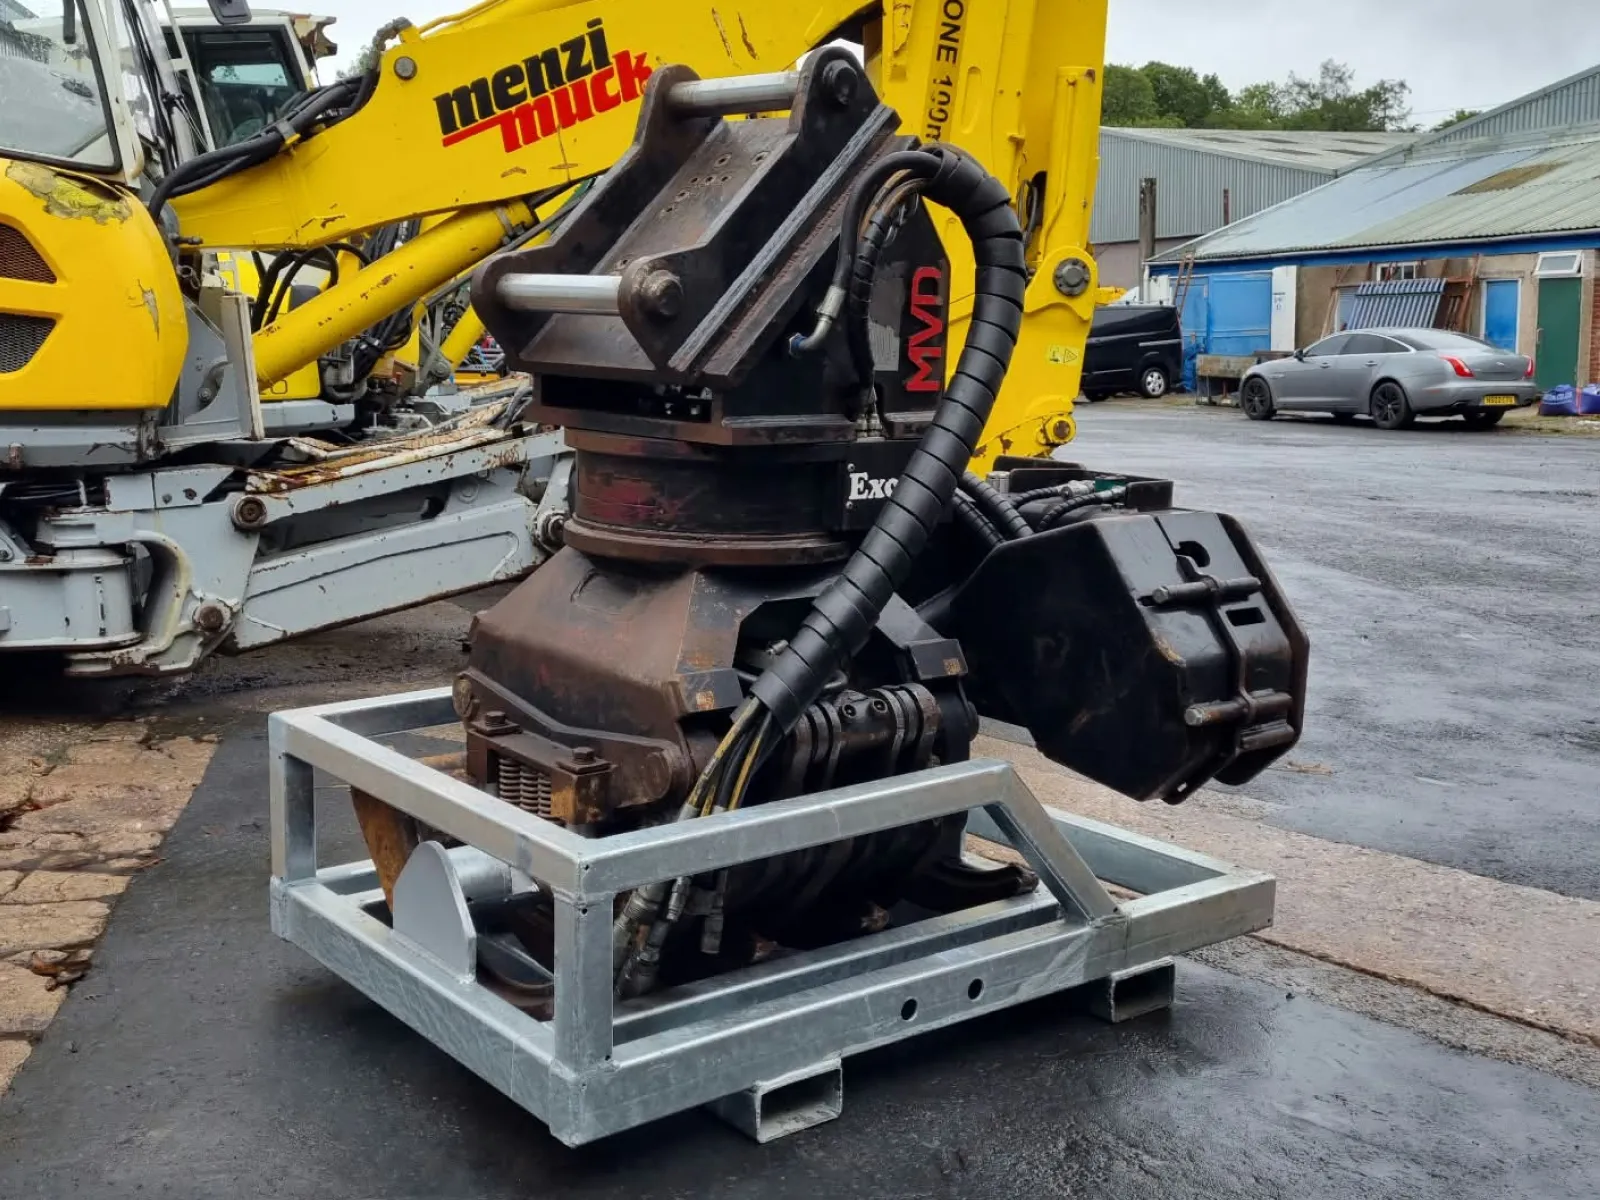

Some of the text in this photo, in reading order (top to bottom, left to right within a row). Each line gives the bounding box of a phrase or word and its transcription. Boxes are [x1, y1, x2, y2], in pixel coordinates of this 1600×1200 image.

[433, 17, 613, 135] menzi
[499, 49, 652, 153] muck
[906, 266, 943, 391] MVD
